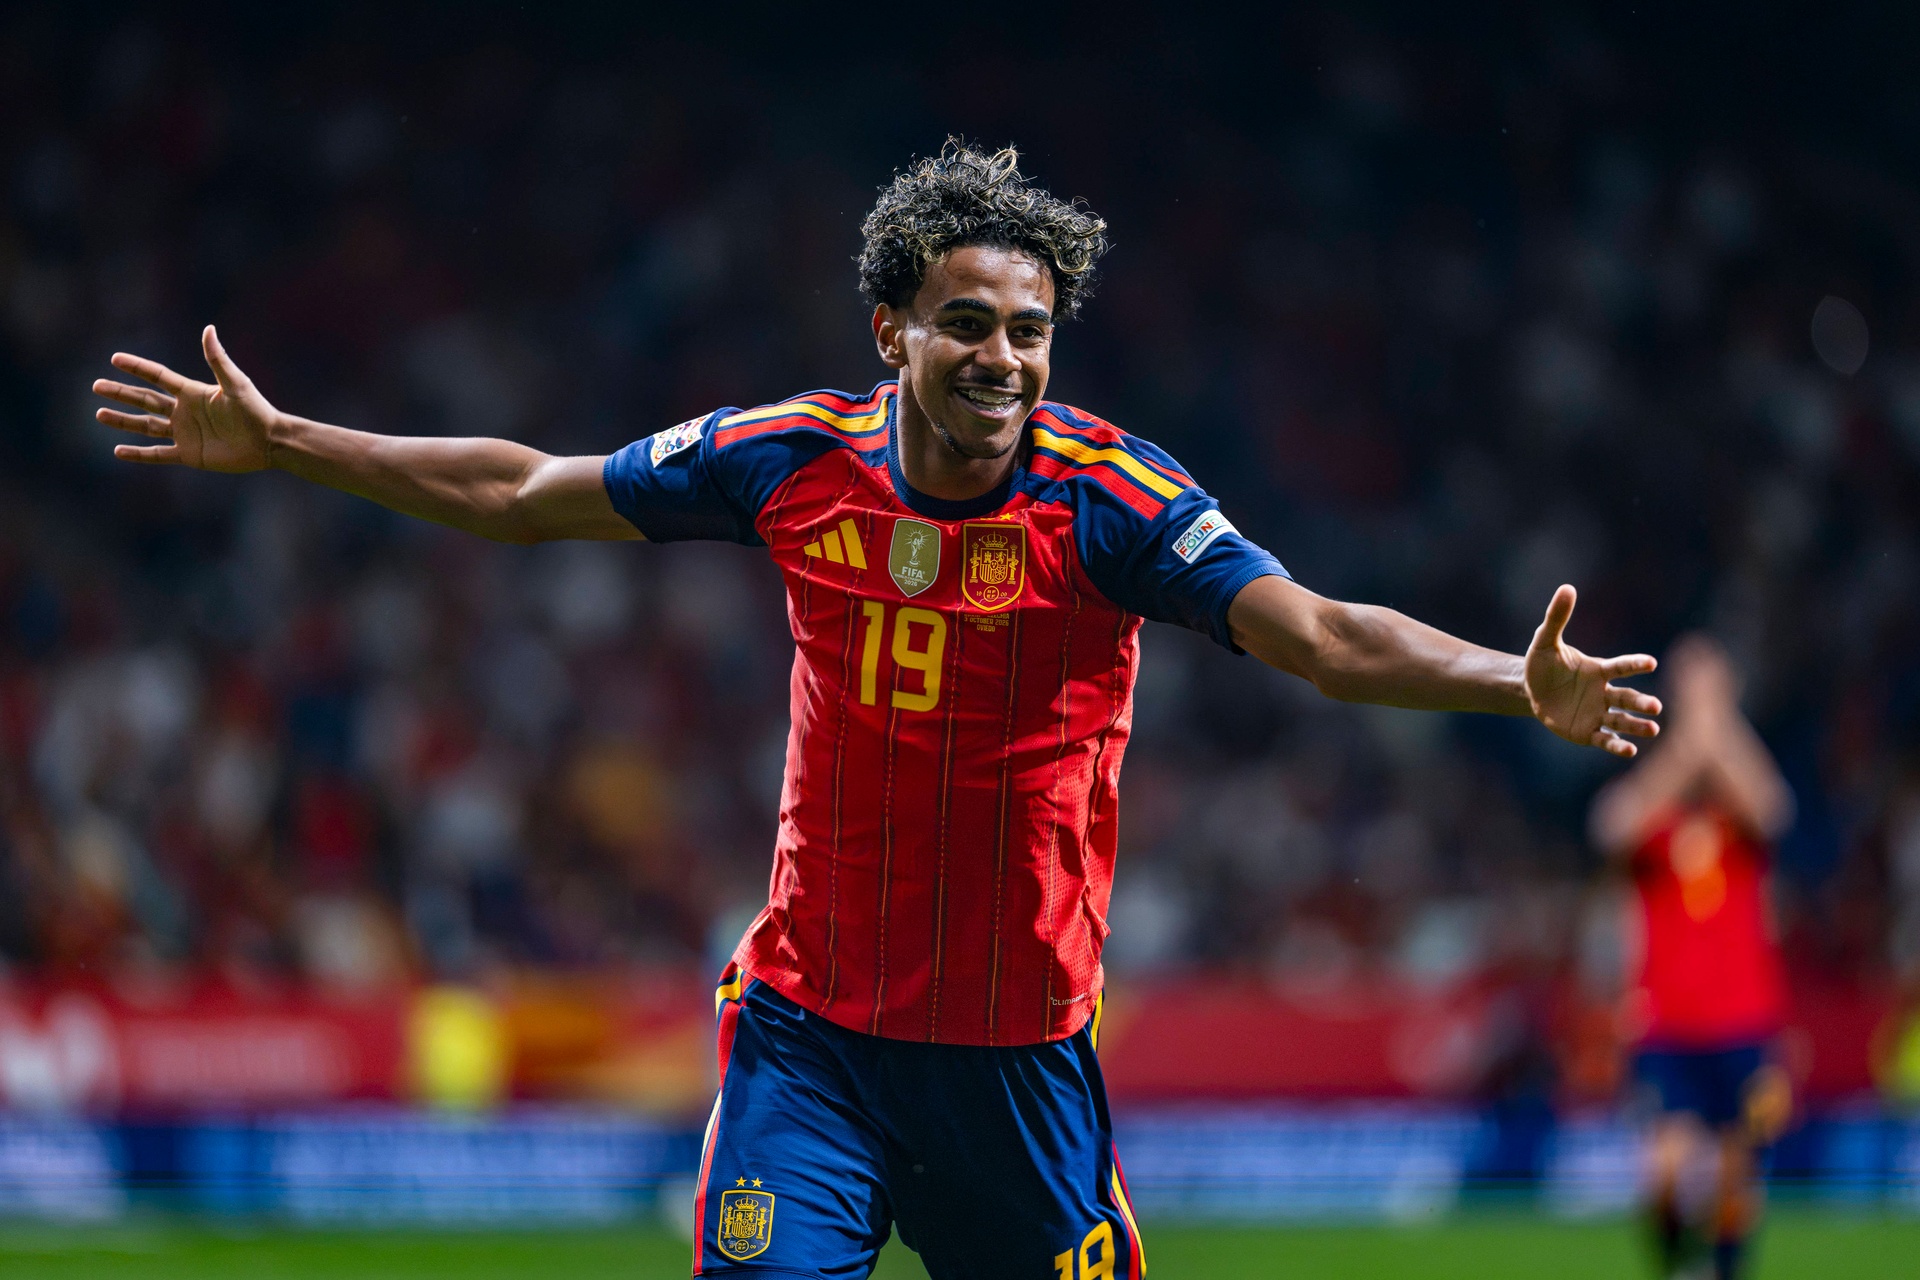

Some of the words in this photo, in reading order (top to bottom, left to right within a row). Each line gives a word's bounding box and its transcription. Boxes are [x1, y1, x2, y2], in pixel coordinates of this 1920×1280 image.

[1174, 531, 1192, 550] UEFA
[901, 566, 923, 579] FIFA
[970, 617, 994, 625] OCTOBER
[860, 600, 947, 712] 19
